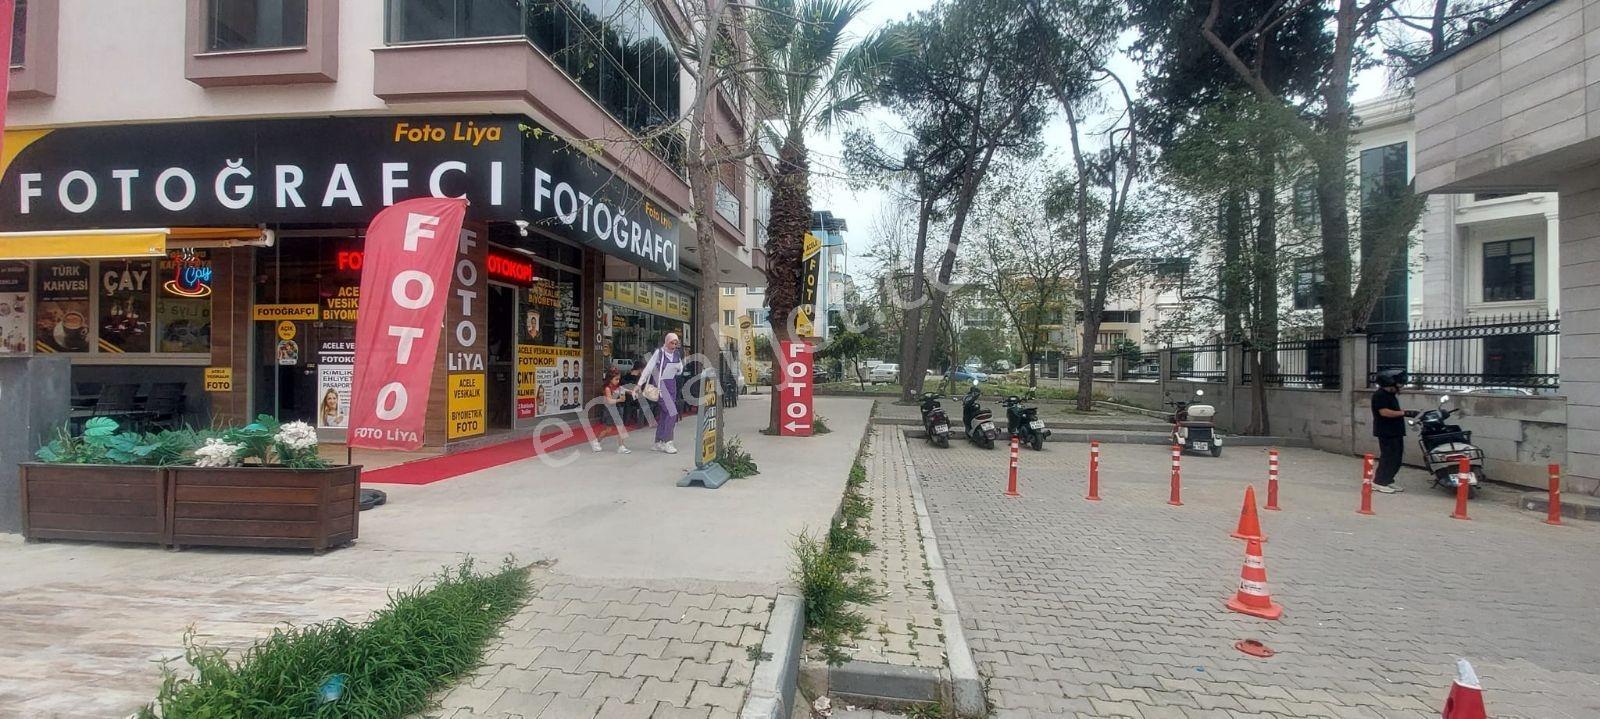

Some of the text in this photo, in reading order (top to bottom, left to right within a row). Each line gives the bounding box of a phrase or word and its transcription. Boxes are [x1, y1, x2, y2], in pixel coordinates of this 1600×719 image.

[395, 121, 502, 146] Foto Liya
[534, 167, 676, 271] FOTOĞRAFÇI
[51, 264, 80, 276] TÜRK
[185, 266, 212, 286] Çay
[43, 278, 88, 291] KAHVESİ
[103, 270, 147, 296] ÇAY
[456, 229, 477, 347] FOTO
[804, 259, 816, 315] FOTO
[257, 306, 315, 317] FOTOĞRAFÇI
[323, 309, 359, 320] BİYOM
[376, 212, 440, 420] FOTO
[322, 342, 344, 350] ACELE
[449, 352, 484, 371] LİYA
[207, 382, 230, 390] FOTO
[459, 379, 476, 388] ACELE
[787, 343, 808, 418] FOTO
[454, 389, 480, 399] VESİKALIK
[355, 427, 418, 442] FOTO LİYA
[457, 421, 478, 433] FOTO
